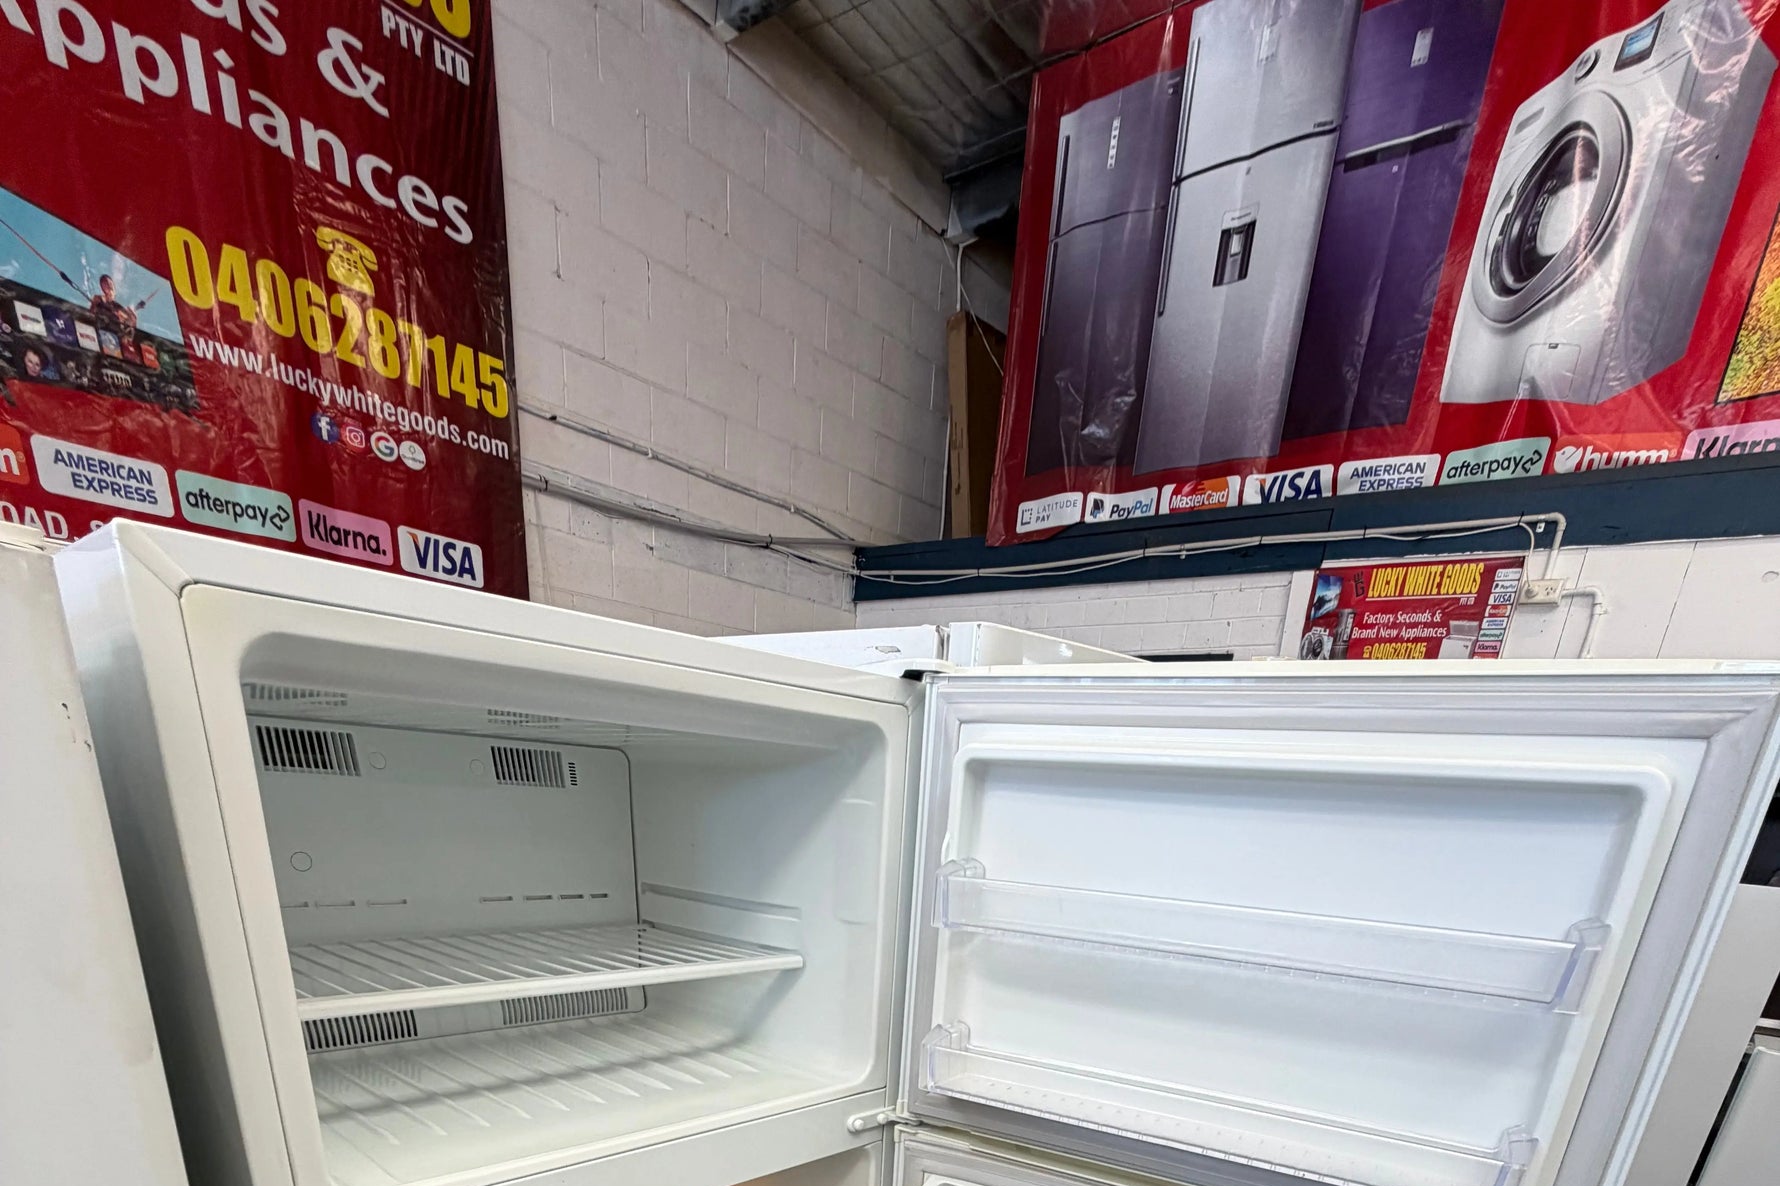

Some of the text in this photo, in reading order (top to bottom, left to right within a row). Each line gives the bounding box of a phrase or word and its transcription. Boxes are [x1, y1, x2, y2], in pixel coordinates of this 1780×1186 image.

[381, 4, 424, 58] PTY
[433, 36, 471, 88] LTD
[317, 27, 389, 117] &
[165, 226, 509, 418] 0406287145
[189, 334, 511, 460] www.luckywhitegoods.com
[53, 448, 154, 486] AMERICAN
[1350, 462, 1427, 480] AMERICAN
[1446, 454, 1525, 479] afterpay
[71, 472, 158, 505] EXPRESS
[1255, 469, 1323, 504] VISA
[1358, 476, 1425, 492] EXPRESS
[185, 487, 270, 527] afterpay
[1036, 499, 1079, 514] LATITUDE
[1109, 498, 1154, 519] PayPal
[1170, 488, 1229, 510] MasterCard
[307, 510, 387, 556] Klarna.
[1035, 513, 1051, 524] PAY
[407, 531, 477, 581] VISA
[1368, 562, 1484, 598] LUCKY WHITE GOODS
[1493, 594, 1512, 604] VISA
[1363, 609, 1443, 626] Factory Seconds &
[1352, 624, 1448, 641] Brand New Appliances
[1371, 642, 1427, 659] 0406287145
